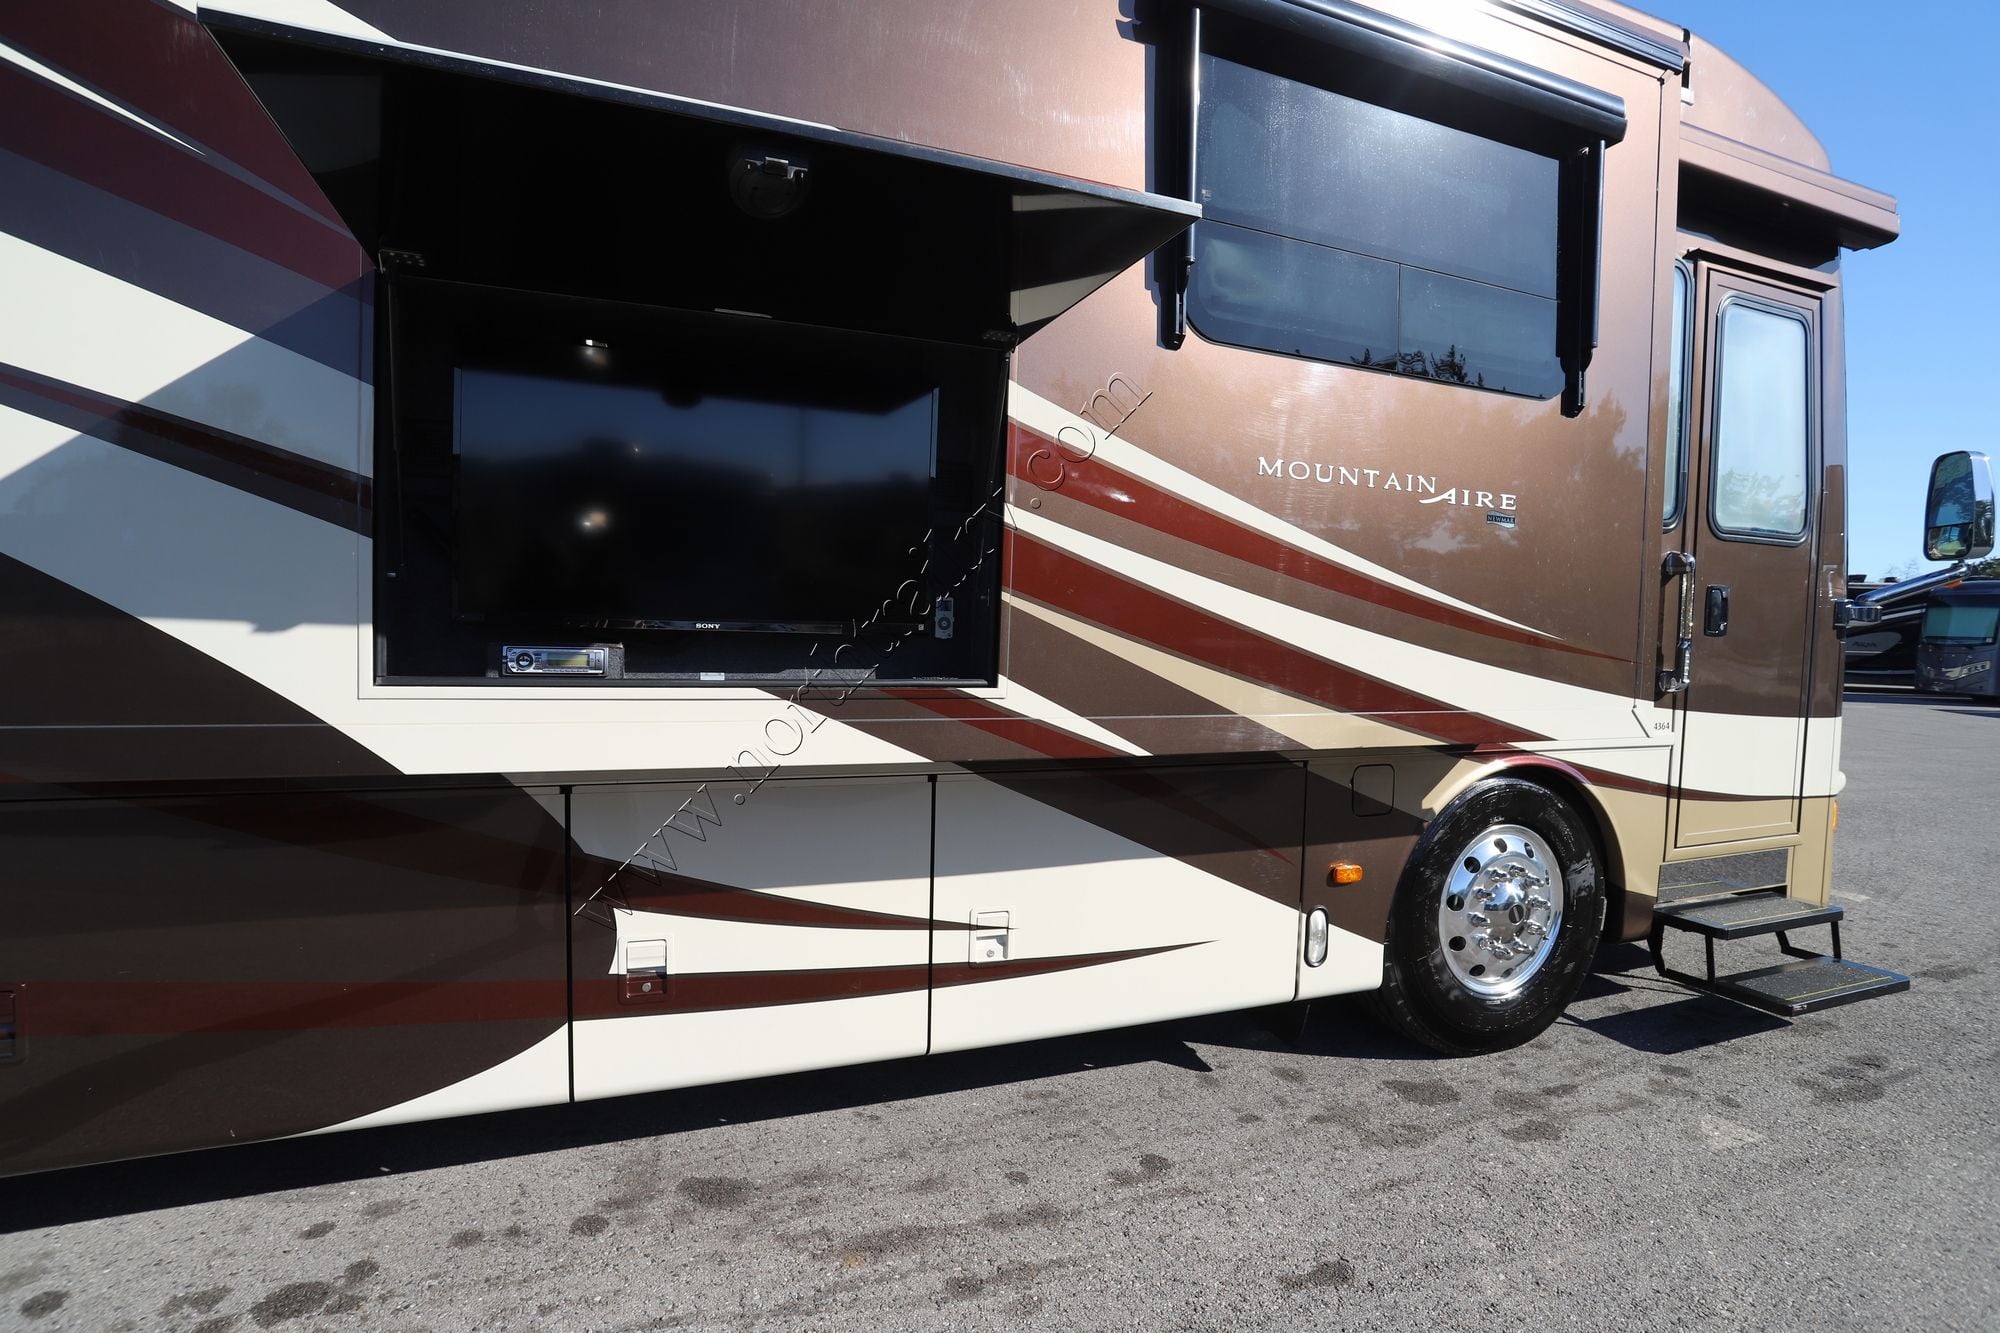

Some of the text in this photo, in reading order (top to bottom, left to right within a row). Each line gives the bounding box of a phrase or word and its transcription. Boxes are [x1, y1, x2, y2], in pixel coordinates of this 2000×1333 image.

[1257, 456, 1517, 511] MOUNTAIN AIRE
[1653, 721, 1670, 731] 4364
